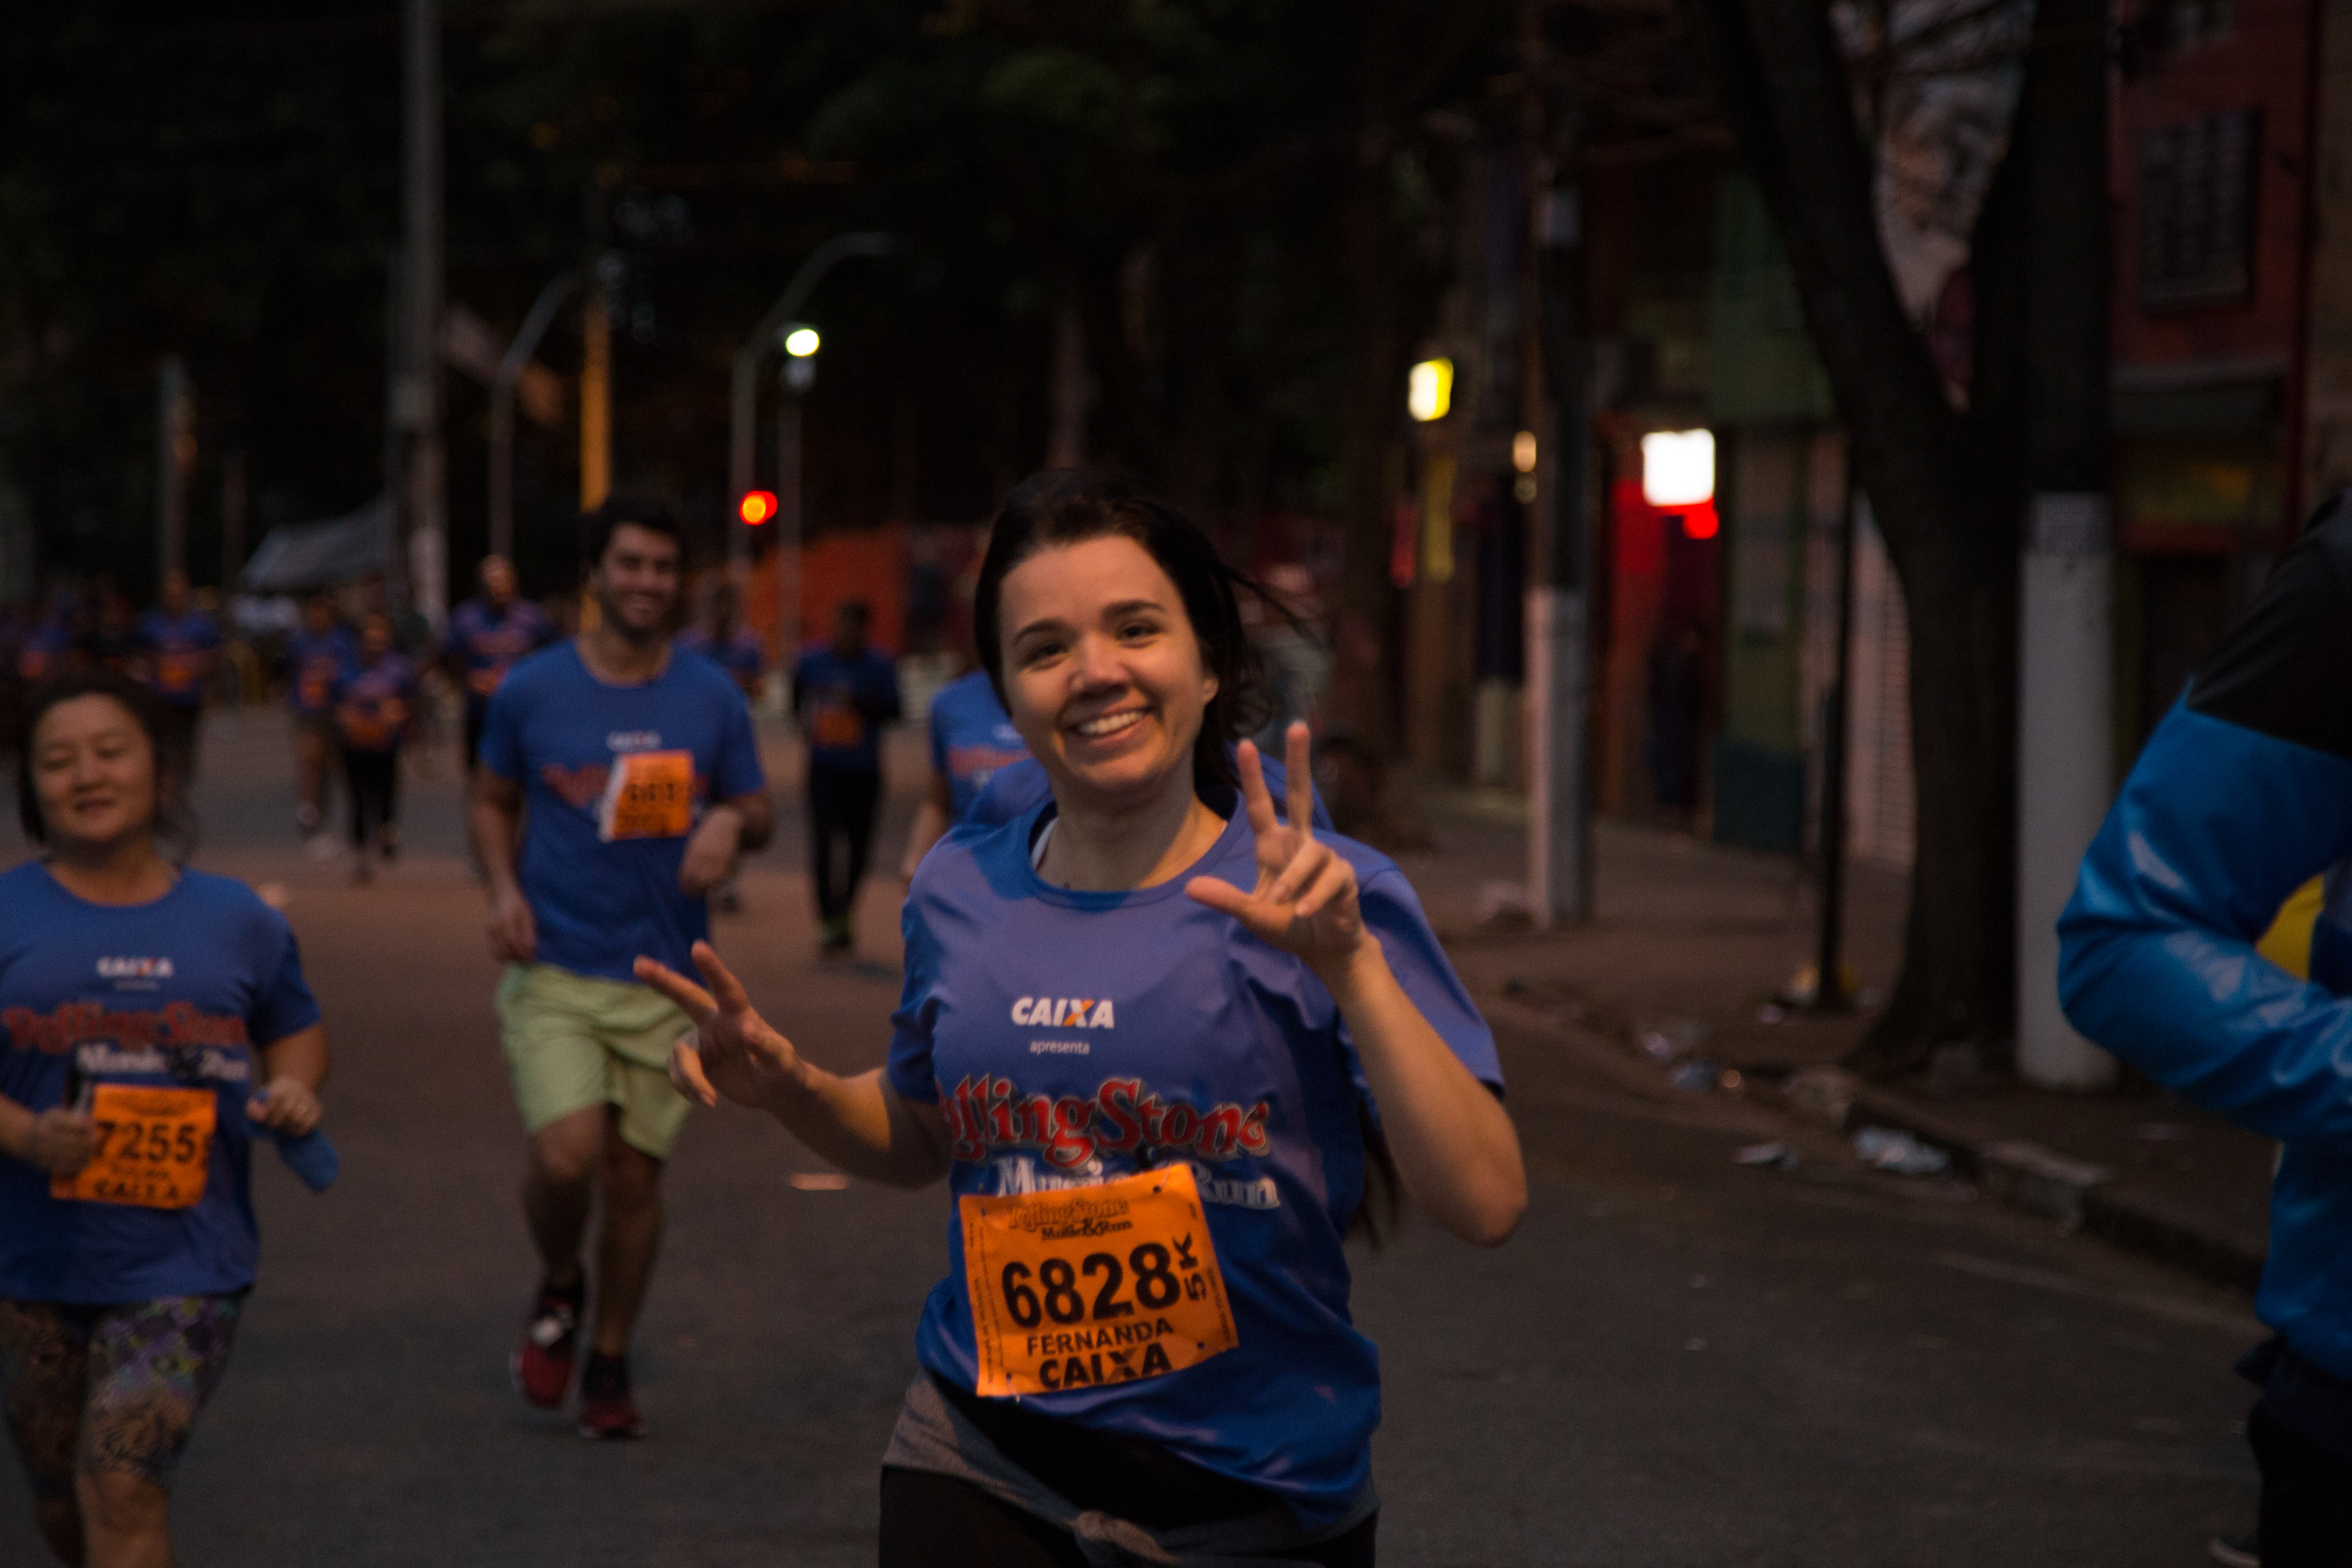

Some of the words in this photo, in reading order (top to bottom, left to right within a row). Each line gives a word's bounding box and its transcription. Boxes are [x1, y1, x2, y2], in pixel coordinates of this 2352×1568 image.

[1011, 996, 1115, 1029] CAIXA
[1030, 1039, 1090, 1056] apresenta
[96, 1121, 195, 1163] 7255
[1002, 1243, 1181, 1329] 6828
[1026, 1317, 1174, 1357] FERNANDA
[1039, 1342, 1173, 1390] CAIXA
